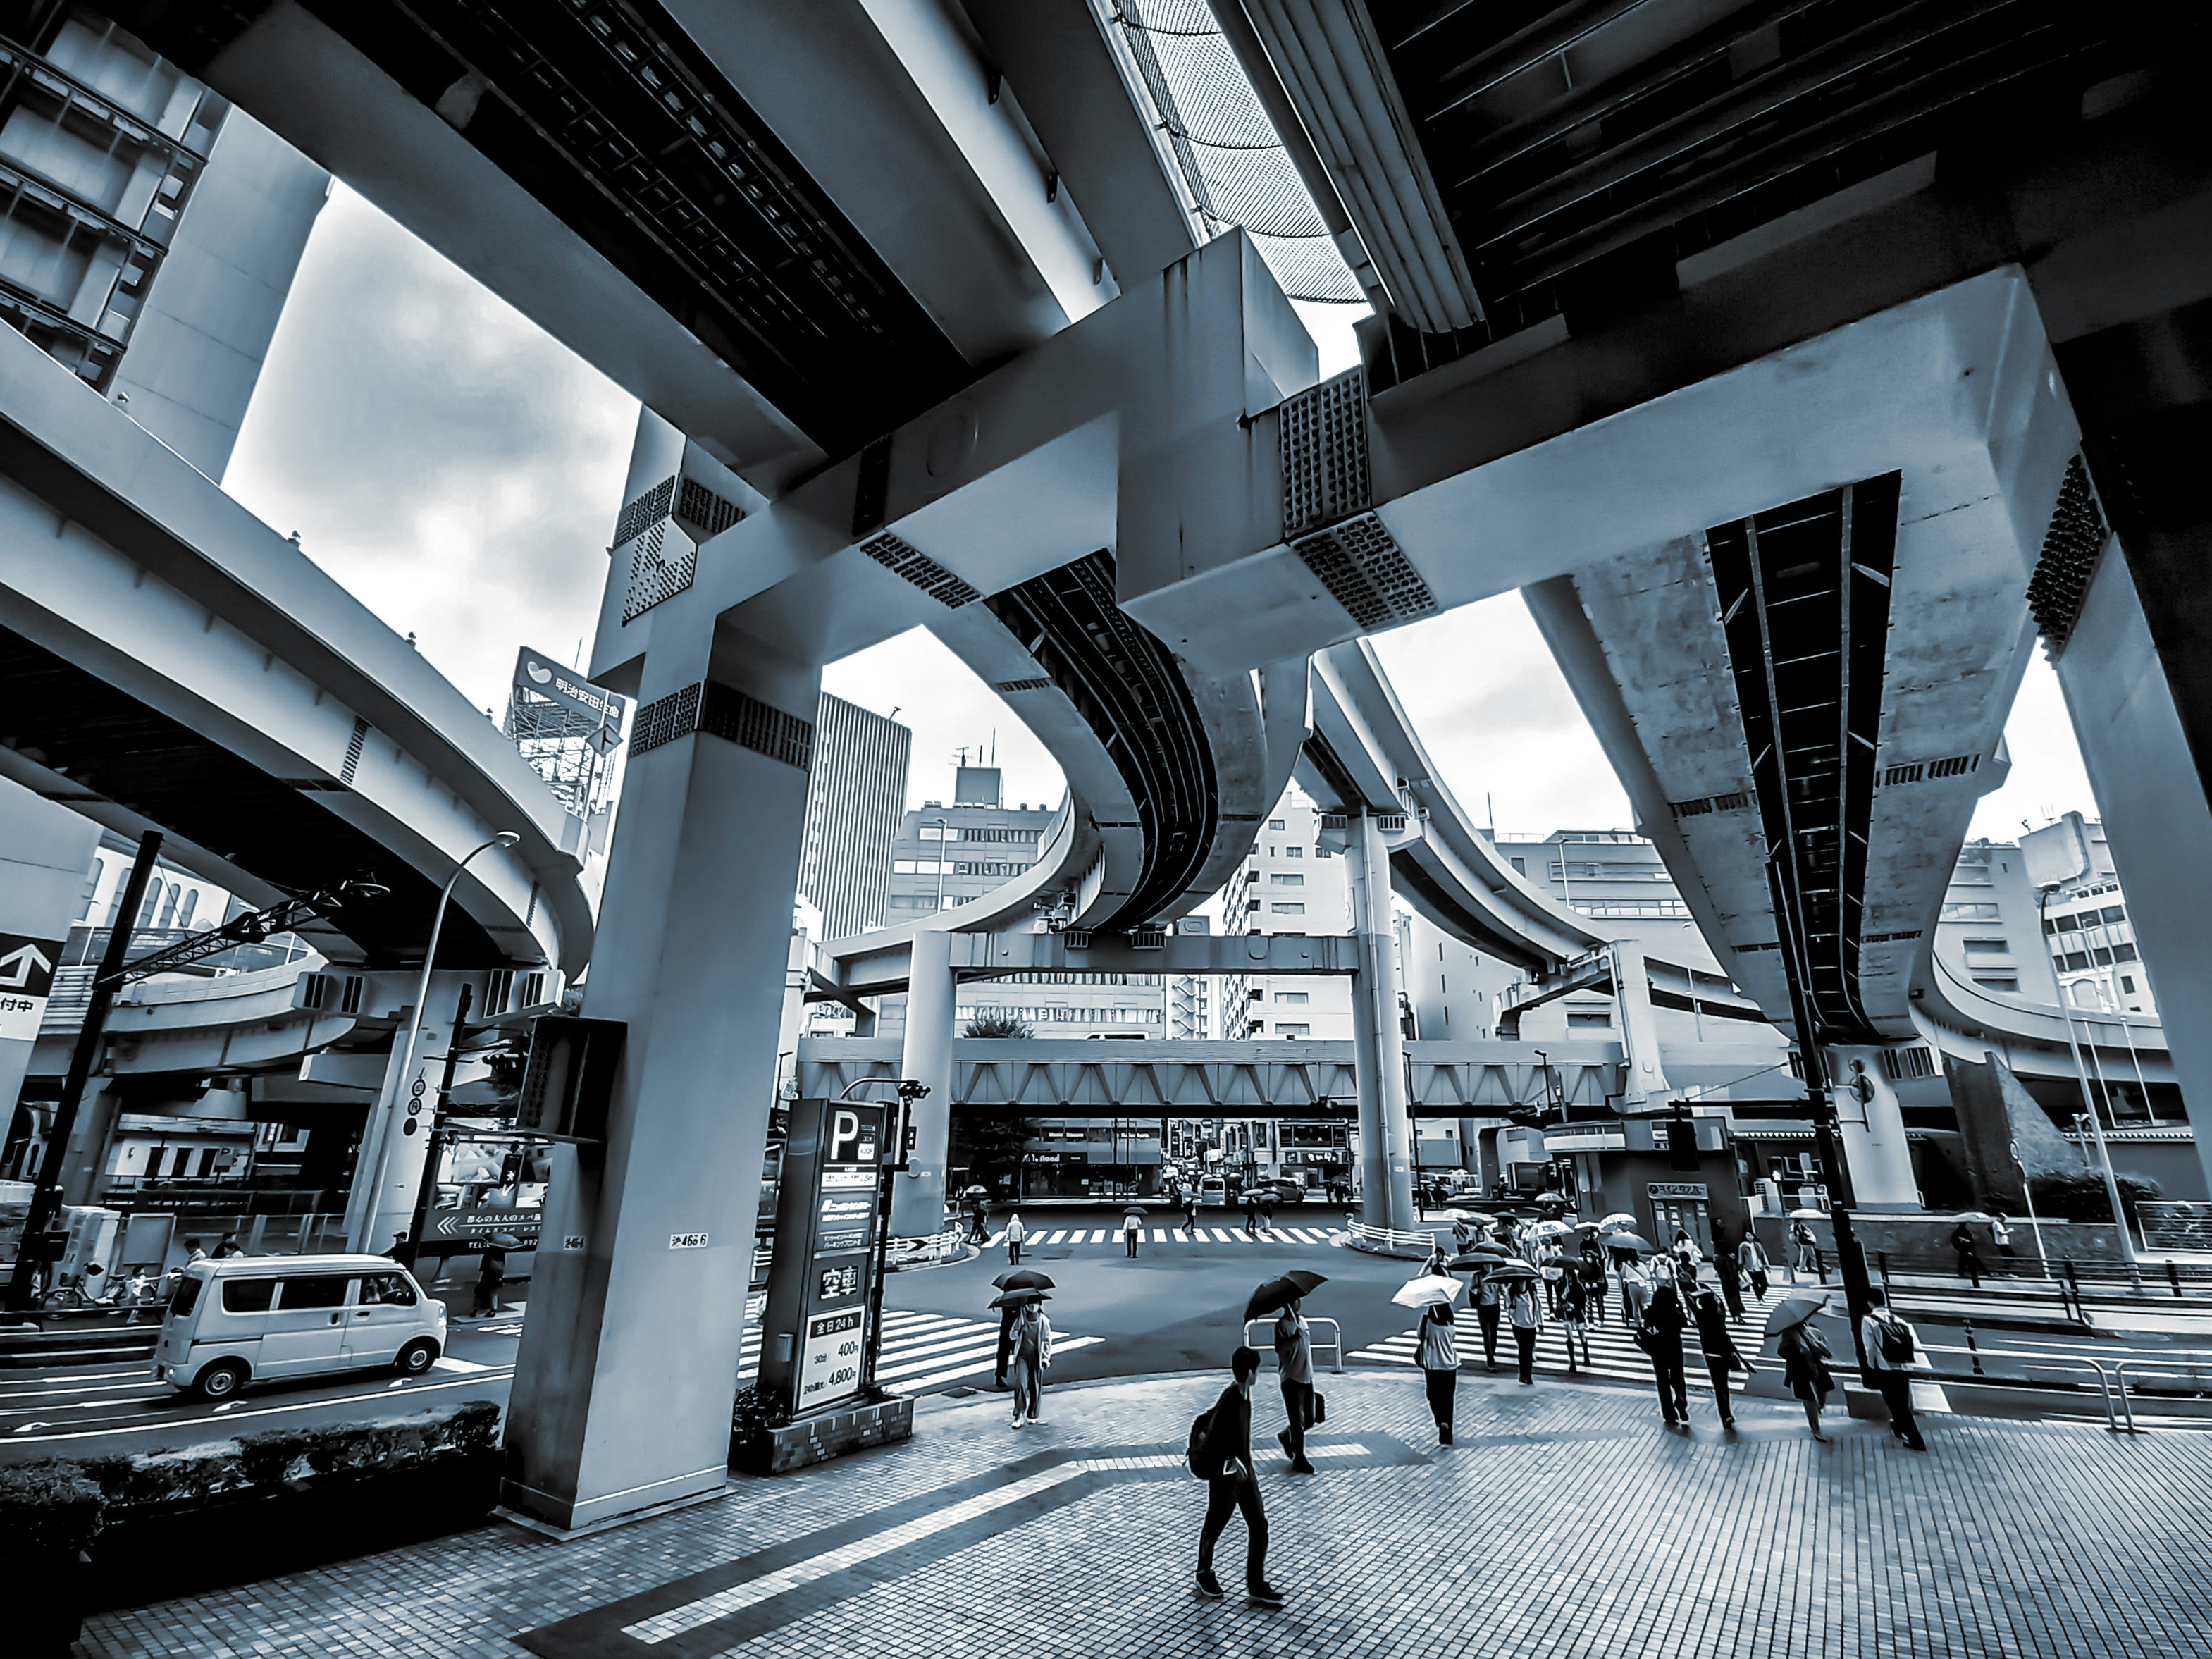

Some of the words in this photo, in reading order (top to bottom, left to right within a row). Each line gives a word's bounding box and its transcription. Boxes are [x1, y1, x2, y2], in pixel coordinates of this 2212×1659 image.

[555, 677, 620, 719] 明治安田生命
[0, 997, 34, 1013] 付中
[830, 1110, 859, 1161] P
[820, 1265, 858, 1300] 空車
